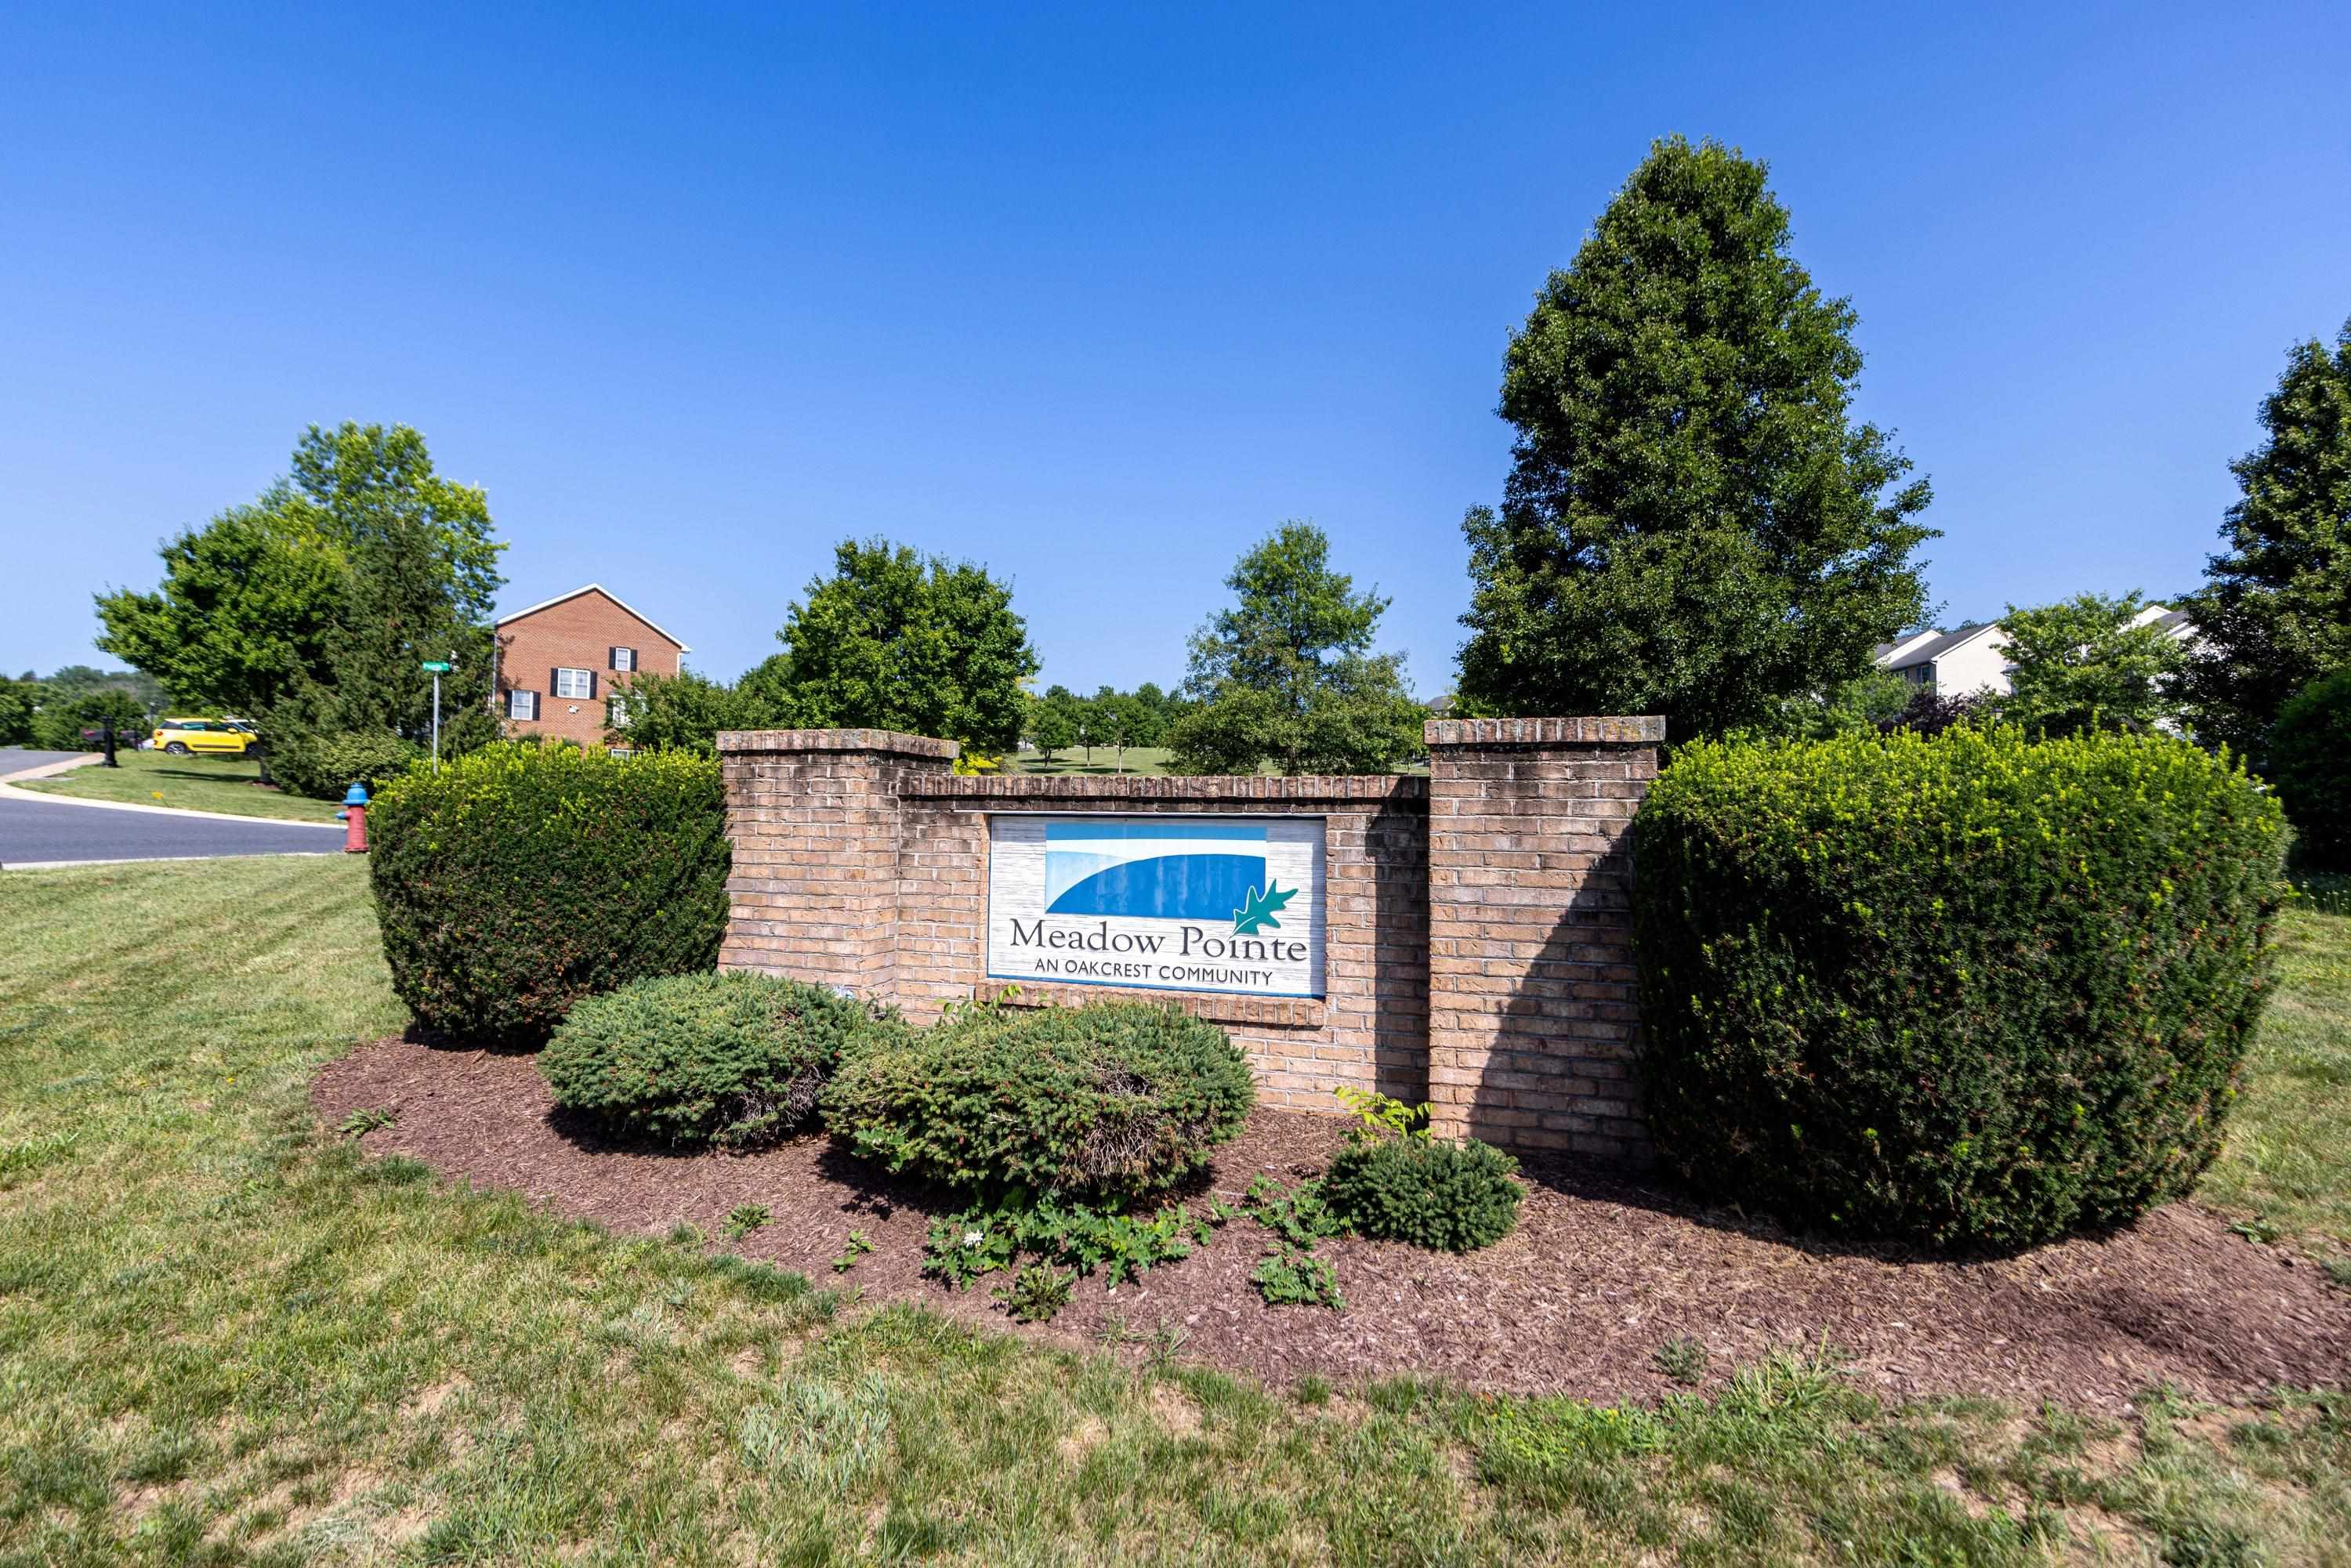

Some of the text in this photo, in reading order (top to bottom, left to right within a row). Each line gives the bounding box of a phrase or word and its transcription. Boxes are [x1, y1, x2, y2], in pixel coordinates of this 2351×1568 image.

[1010, 918, 1307, 961] Meadow Pointe
[1034, 958, 1273, 985] AN OAKCREST COMMUNITY
